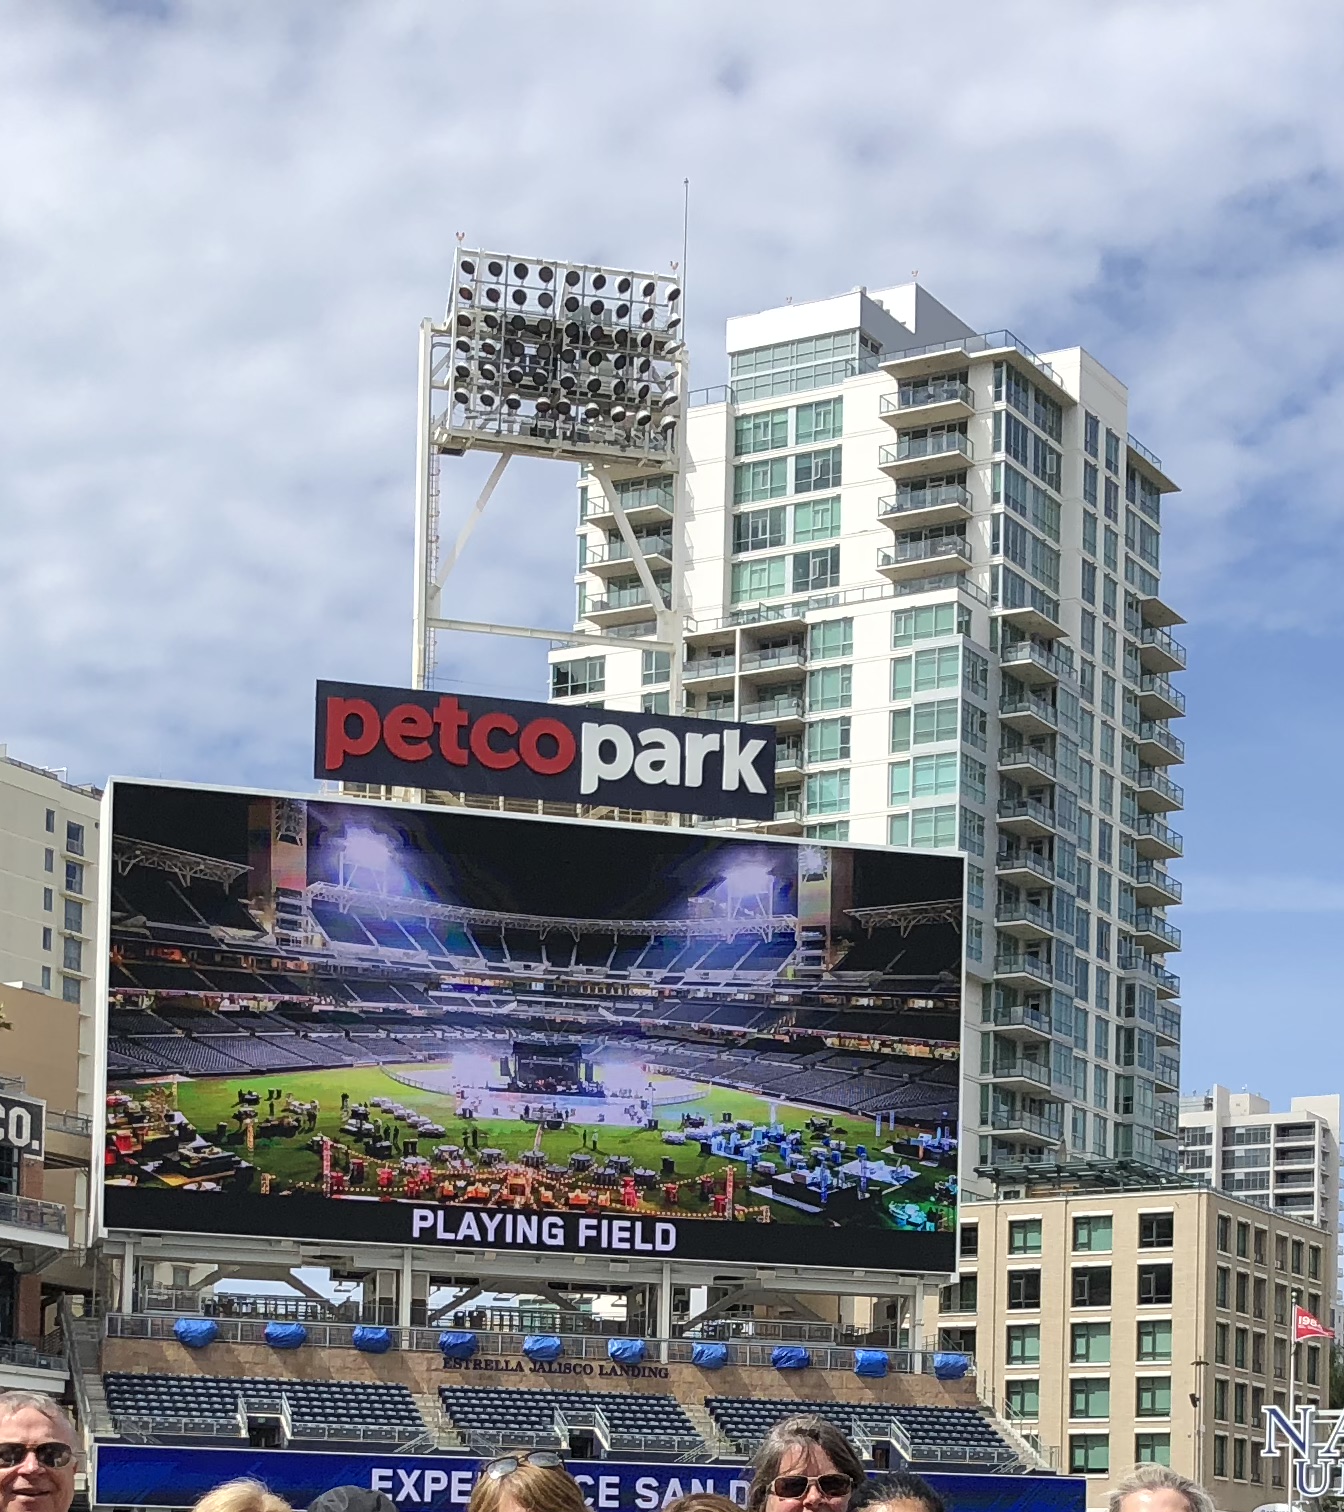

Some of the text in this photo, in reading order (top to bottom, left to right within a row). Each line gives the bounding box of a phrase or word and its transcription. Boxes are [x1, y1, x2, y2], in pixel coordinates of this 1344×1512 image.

[325, 695, 768, 795] petco park
[412, 1208, 677, 1251] PLAYING FIELD
[442, 1356, 670, 1379] ESTRELLA JALISCO LANDING
[371, 1468, 621, 1509] EXPECE
